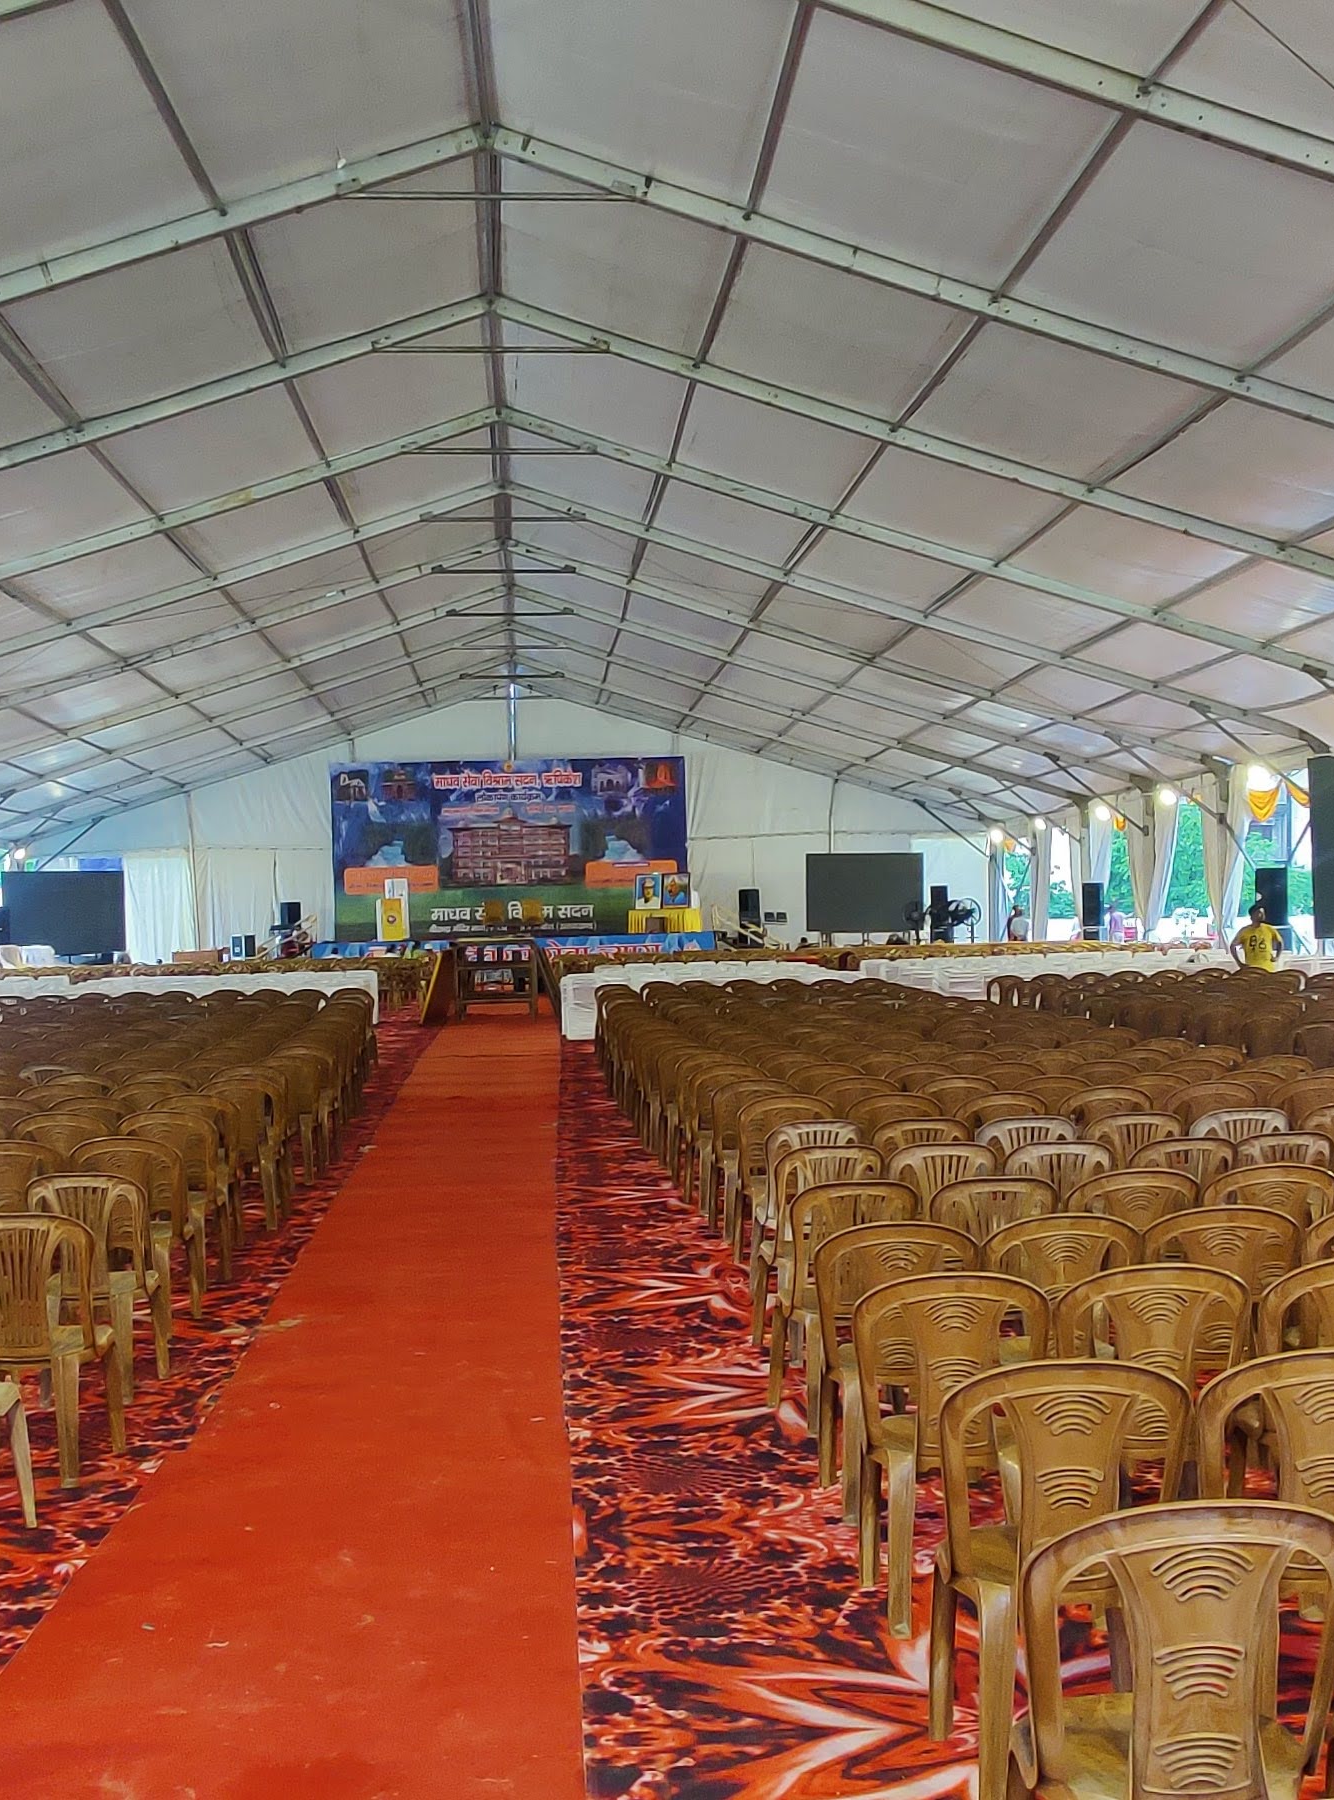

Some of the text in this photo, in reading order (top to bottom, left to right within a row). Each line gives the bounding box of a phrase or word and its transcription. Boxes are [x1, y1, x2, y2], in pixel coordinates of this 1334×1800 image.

[434, 773, 461, 788] माधव
[461, 770, 479, 789] सेवा
[479, 769, 512, 788] विश्राम
[430, 907, 470, 921] माधव
[557, 904, 594, 919] सदन
